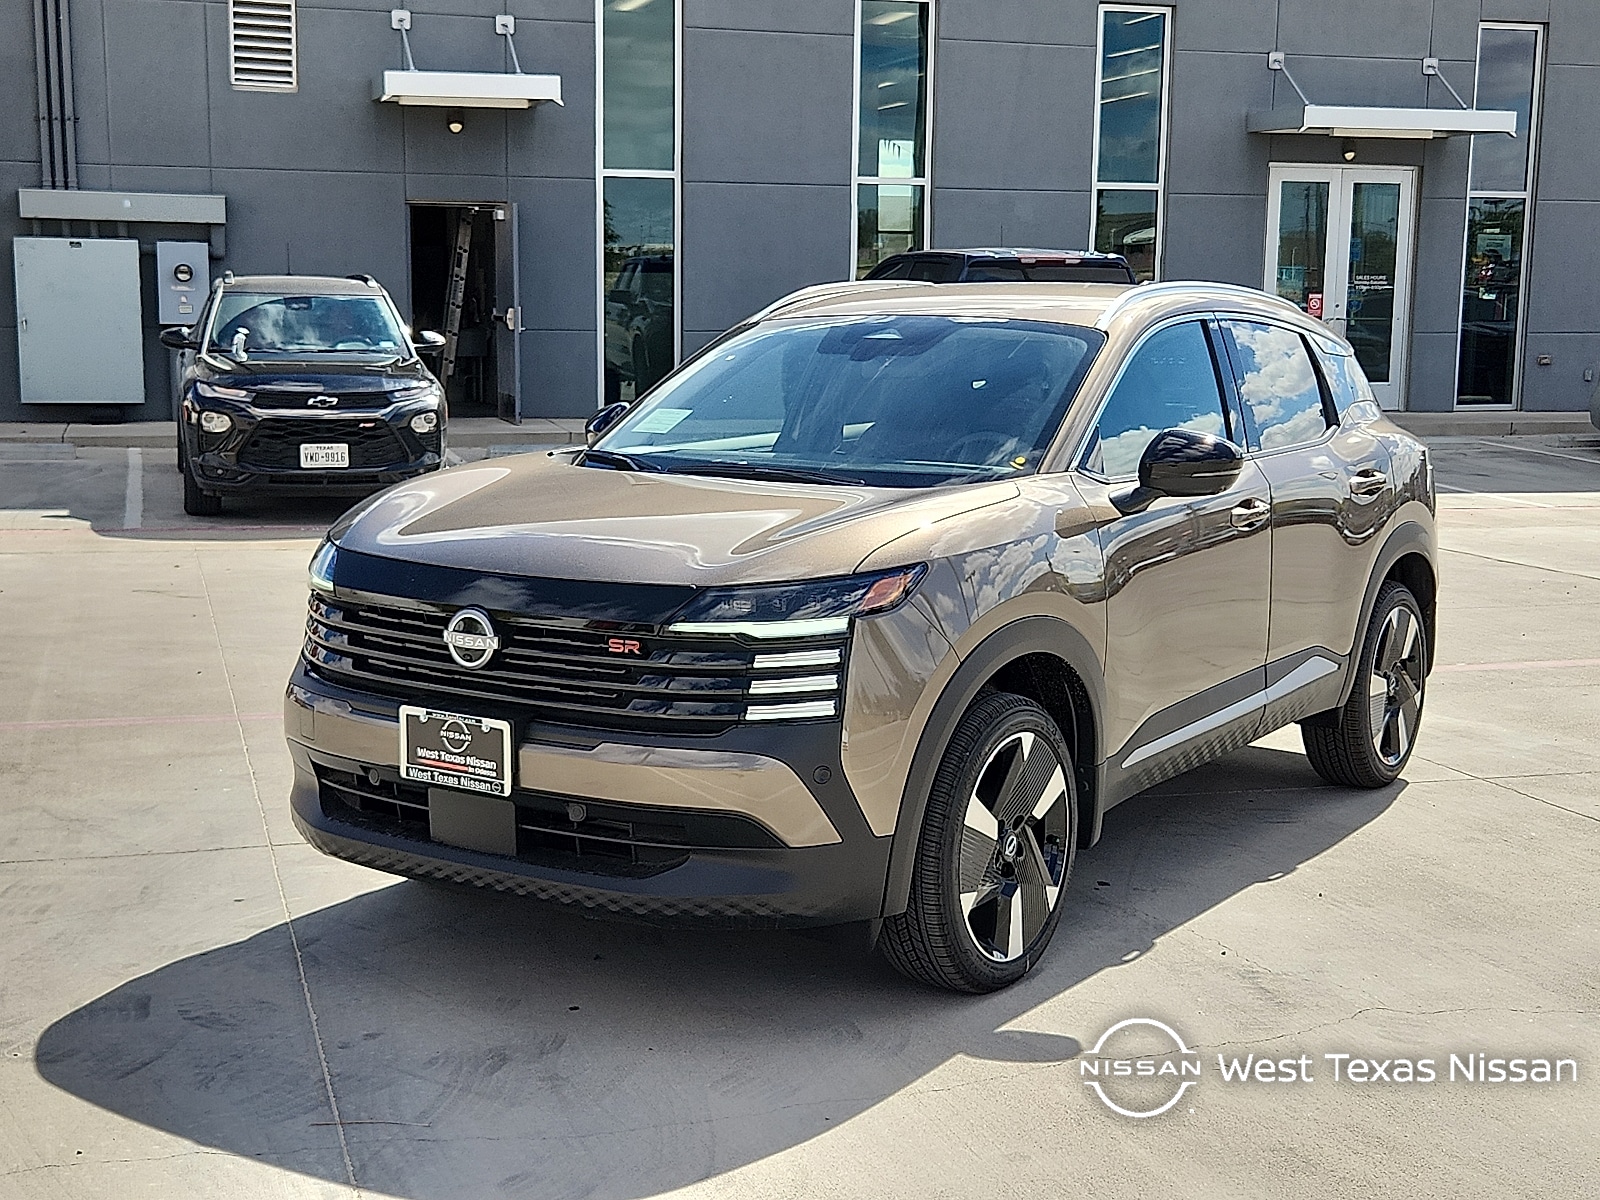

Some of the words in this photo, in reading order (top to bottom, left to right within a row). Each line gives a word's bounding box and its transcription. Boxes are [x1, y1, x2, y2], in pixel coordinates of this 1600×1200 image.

[444, 630, 498, 649] NISSAN
[608, 638, 641, 655] SR
[440, 730, 472, 741] NISSAN
[416, 746, 439, 760] West
[440, 751, 466, 764] Texas
[466, 756, 497, 770] Nissan
[408, 767, 432, 780] West
[433, 771, 459, 785] Texas
[460, 776, 492, 791] Nissan
